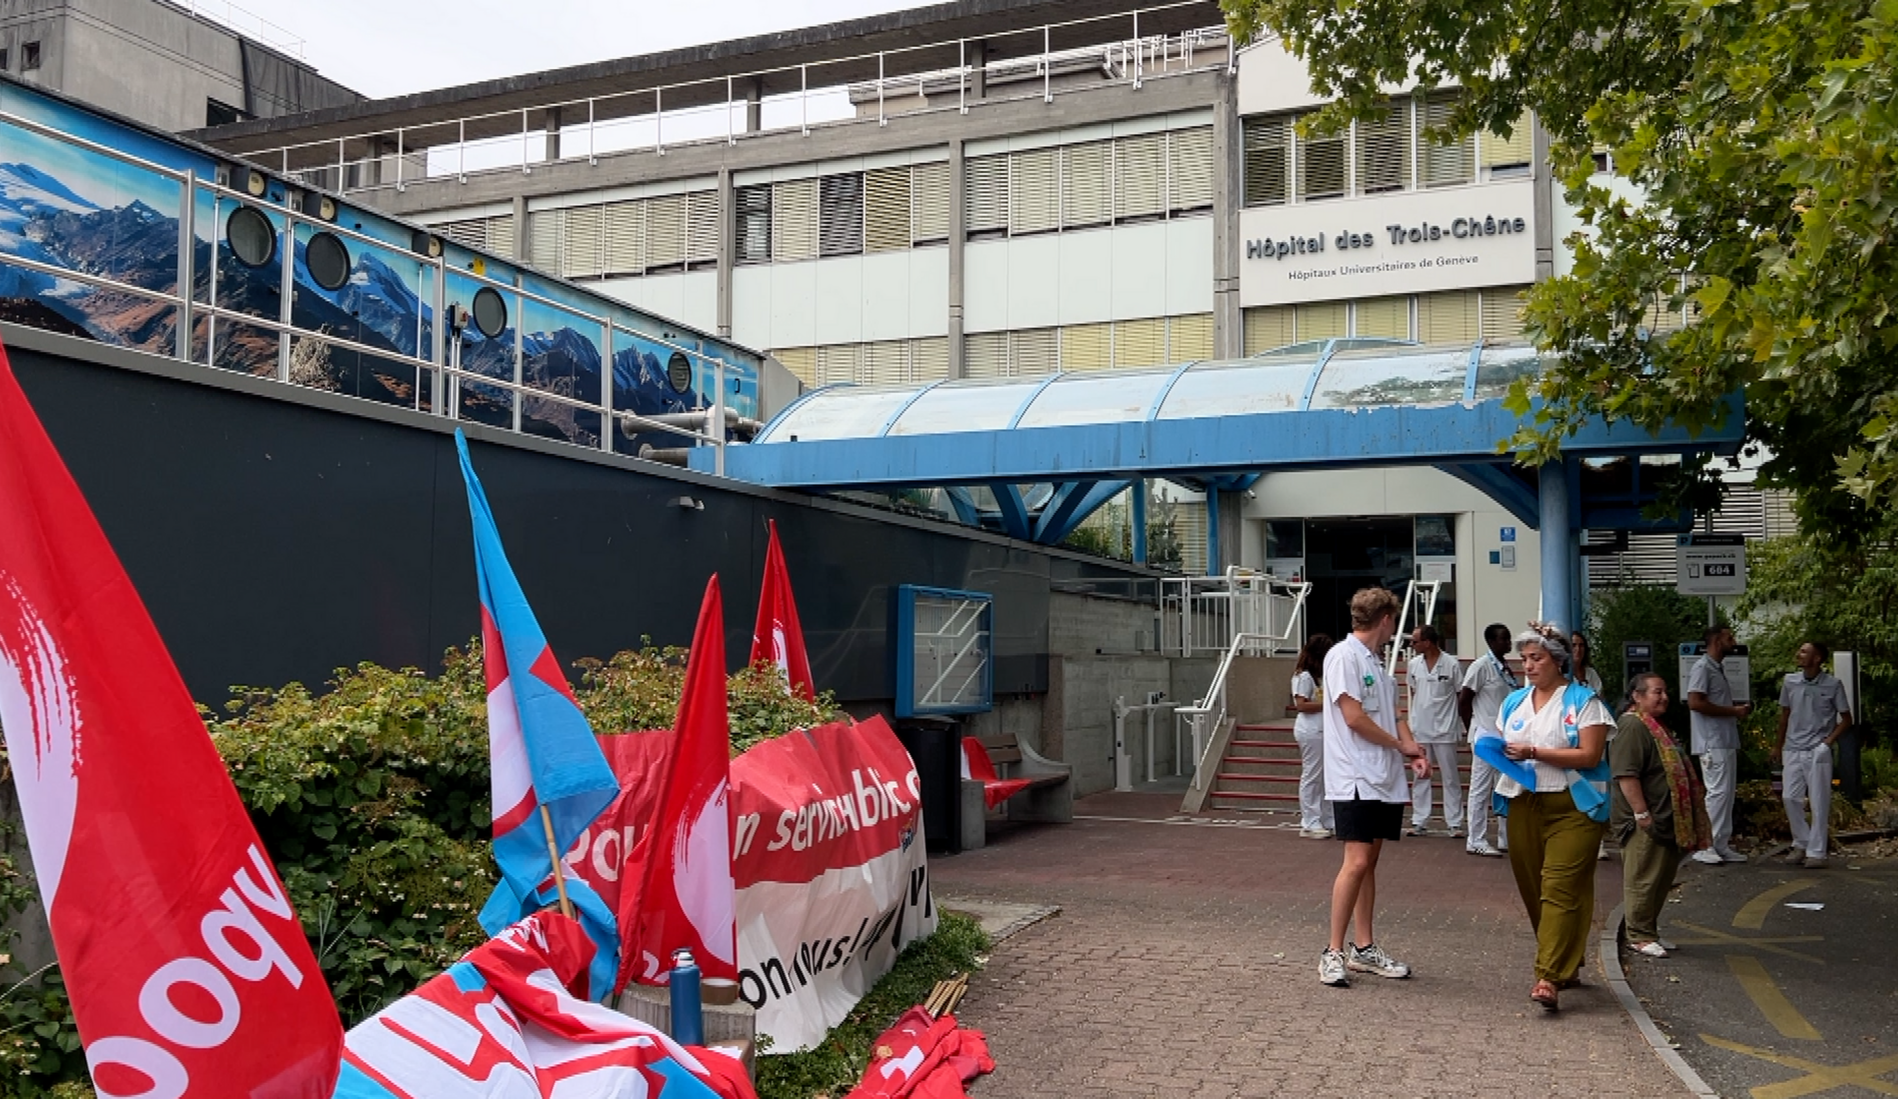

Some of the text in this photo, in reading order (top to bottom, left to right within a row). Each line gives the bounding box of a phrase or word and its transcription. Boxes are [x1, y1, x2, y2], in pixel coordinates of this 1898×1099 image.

[1246, 213, 1526, 261] Hôpital des Trois-Chêne
[1288, 254, 1479, 282] Hôpitaux Universitaires de Genève
